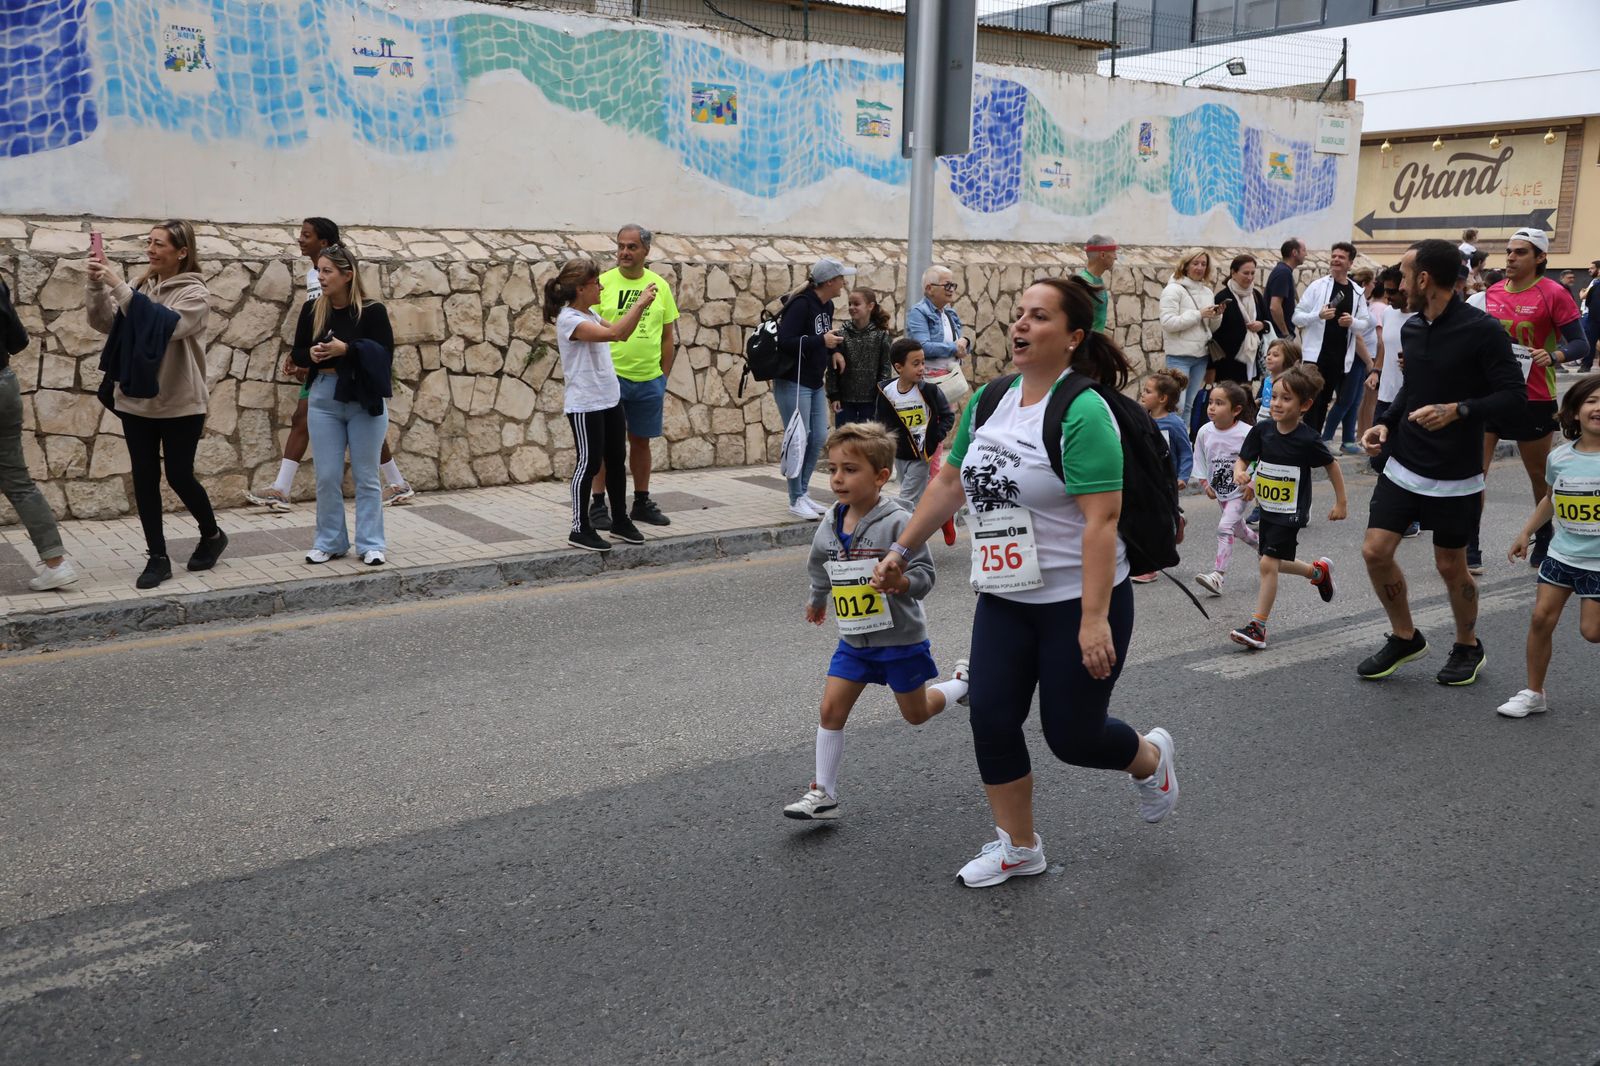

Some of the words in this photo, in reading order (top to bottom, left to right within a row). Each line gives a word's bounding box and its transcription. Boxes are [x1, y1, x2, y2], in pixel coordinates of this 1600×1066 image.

[1382, 154, 1401, 169] LE
[1389, 146, 1514, 214] Grand
[1500, 181, 1543, 197] CAFÉ
[1257, 483, 1291, 502] 1003
[980, 542, 1023, 572] 256
[832, 594, 879, 618] 1012
